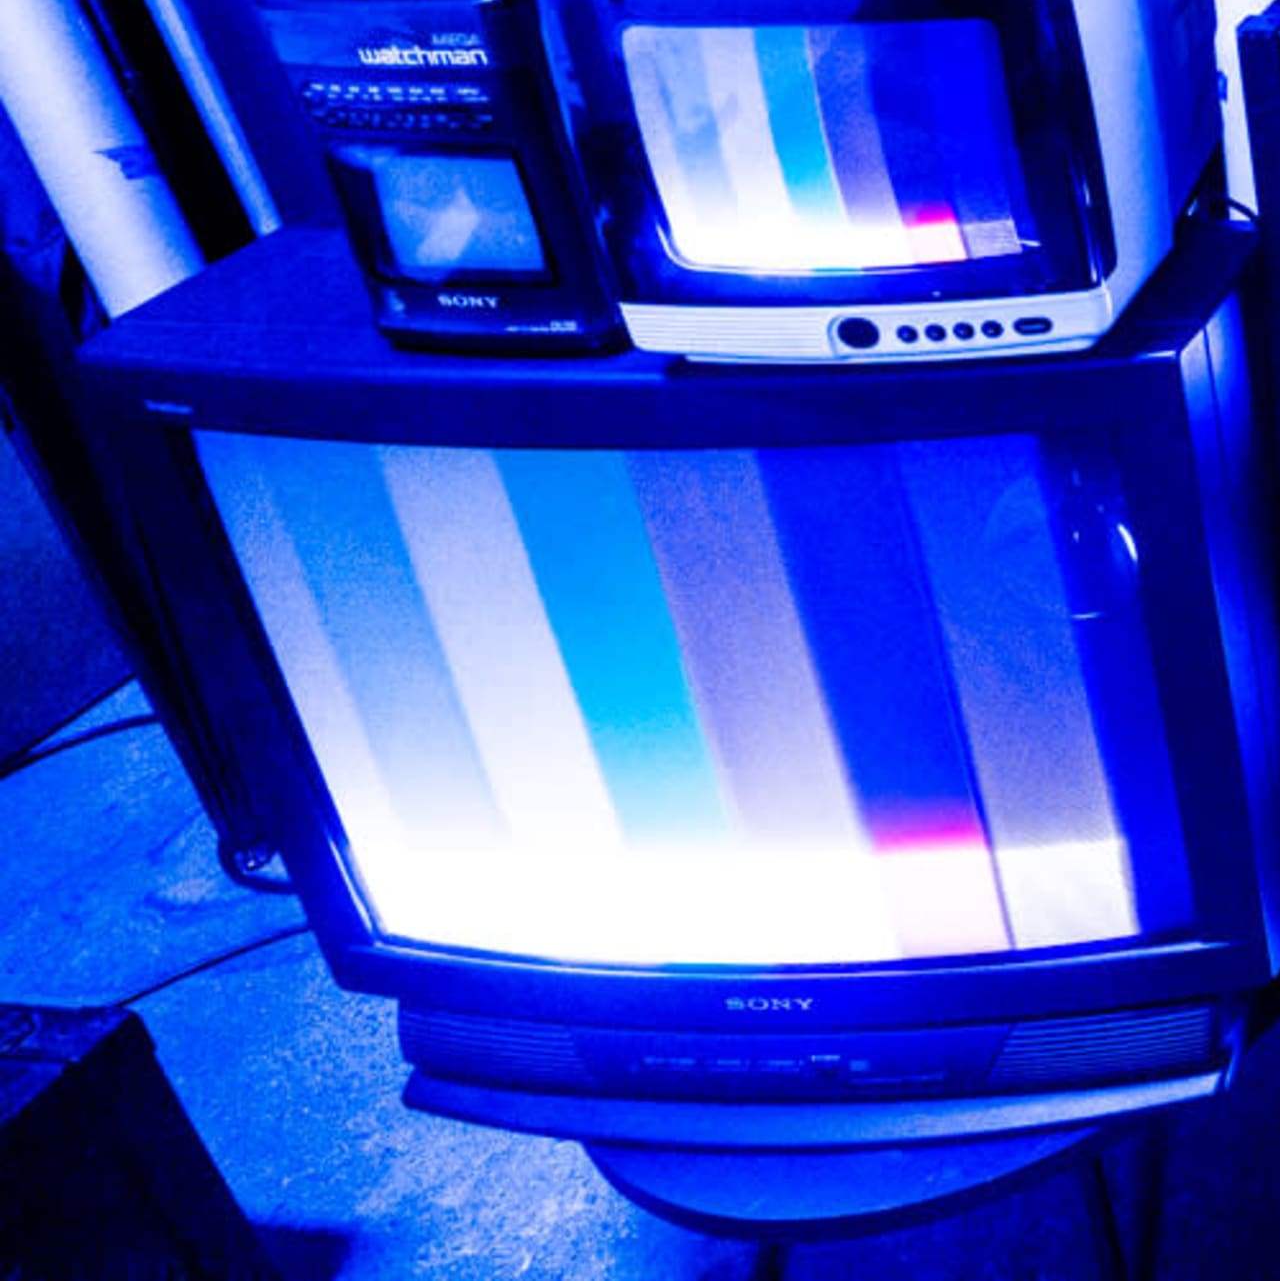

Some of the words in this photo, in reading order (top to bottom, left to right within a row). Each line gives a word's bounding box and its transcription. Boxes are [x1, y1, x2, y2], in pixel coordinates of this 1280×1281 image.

[357, 45, 488, 66] watchman
[437, 293, 500, 310] SONY
[725, 997, 814, 1012] SONY
